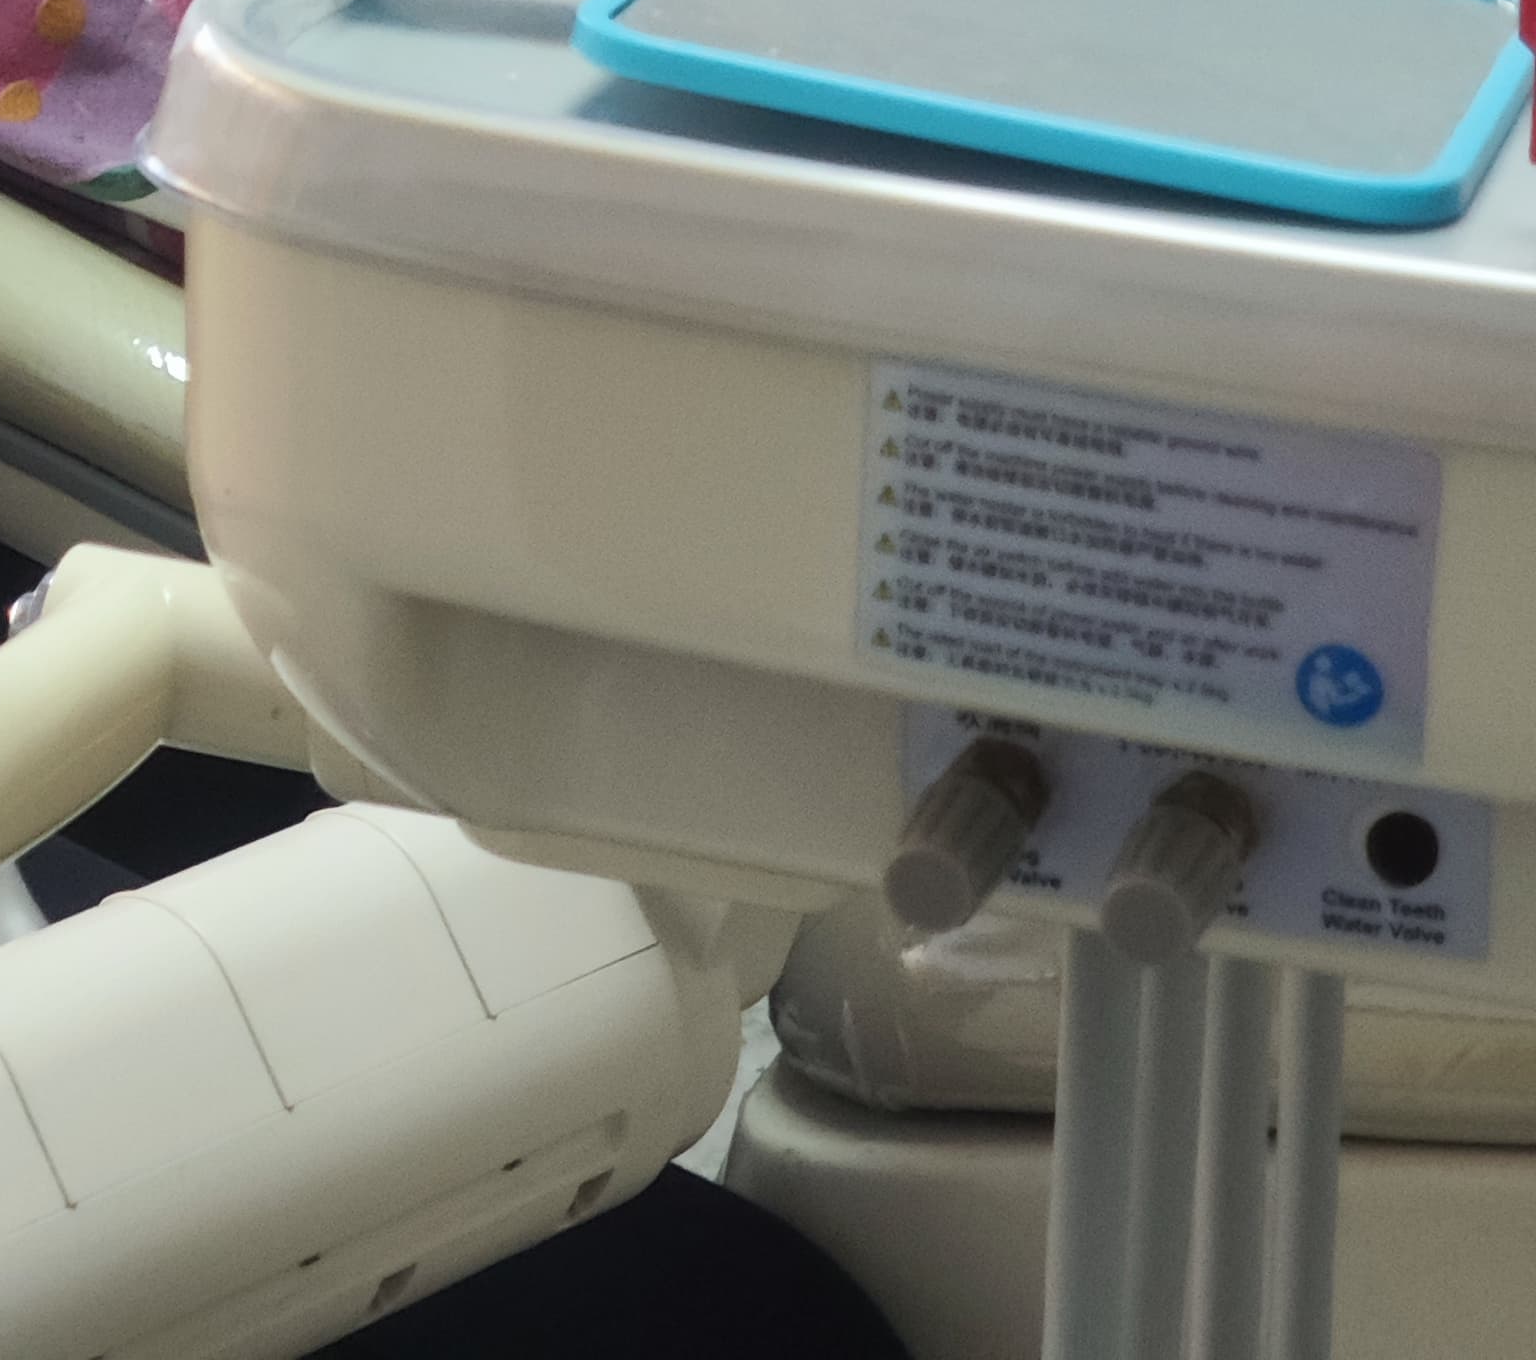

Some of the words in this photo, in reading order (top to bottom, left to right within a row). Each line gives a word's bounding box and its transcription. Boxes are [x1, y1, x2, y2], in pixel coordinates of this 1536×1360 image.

[1322, 887, 1381, 913] Clean
[1389, 898, 1446, 921] Teeth
[1322, 913, 1381, 937] Water
[1389, 922, 1445, 945] Valve
